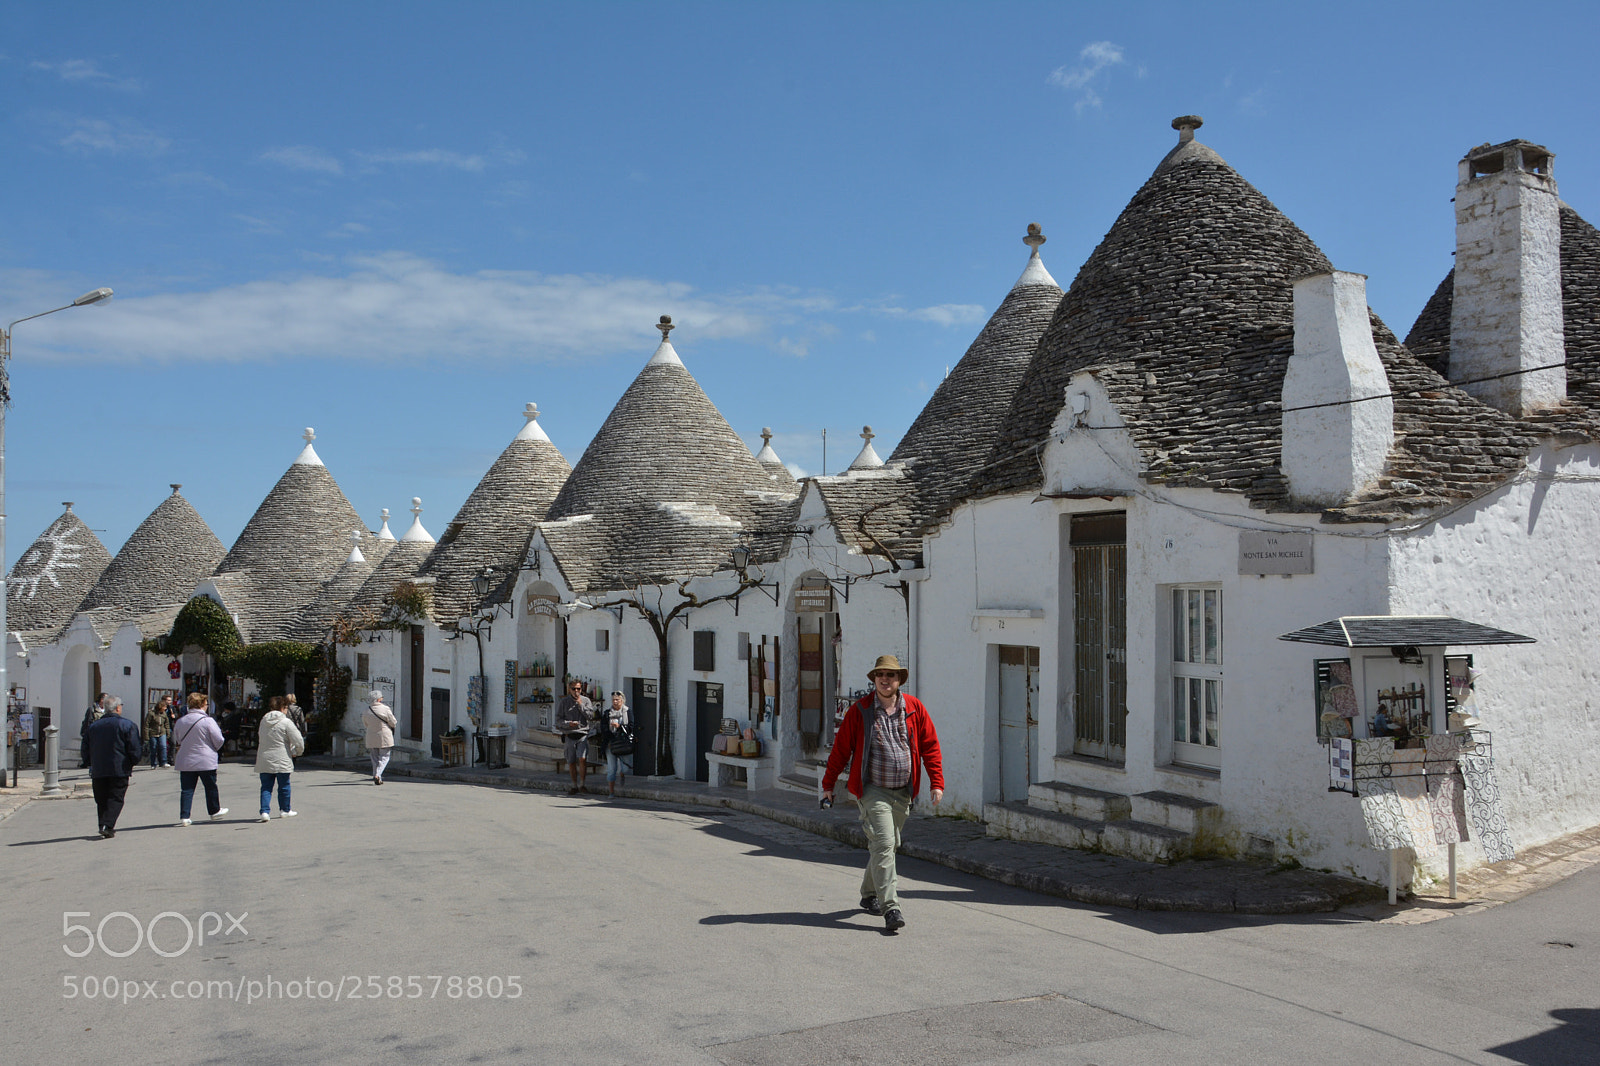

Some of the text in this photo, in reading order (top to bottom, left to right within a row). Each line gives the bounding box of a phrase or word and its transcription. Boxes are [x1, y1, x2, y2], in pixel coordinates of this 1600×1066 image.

[1243, 549, 1304, 559] MONTE SAN MICHELE
[998, 619, 1005, 629] 72
